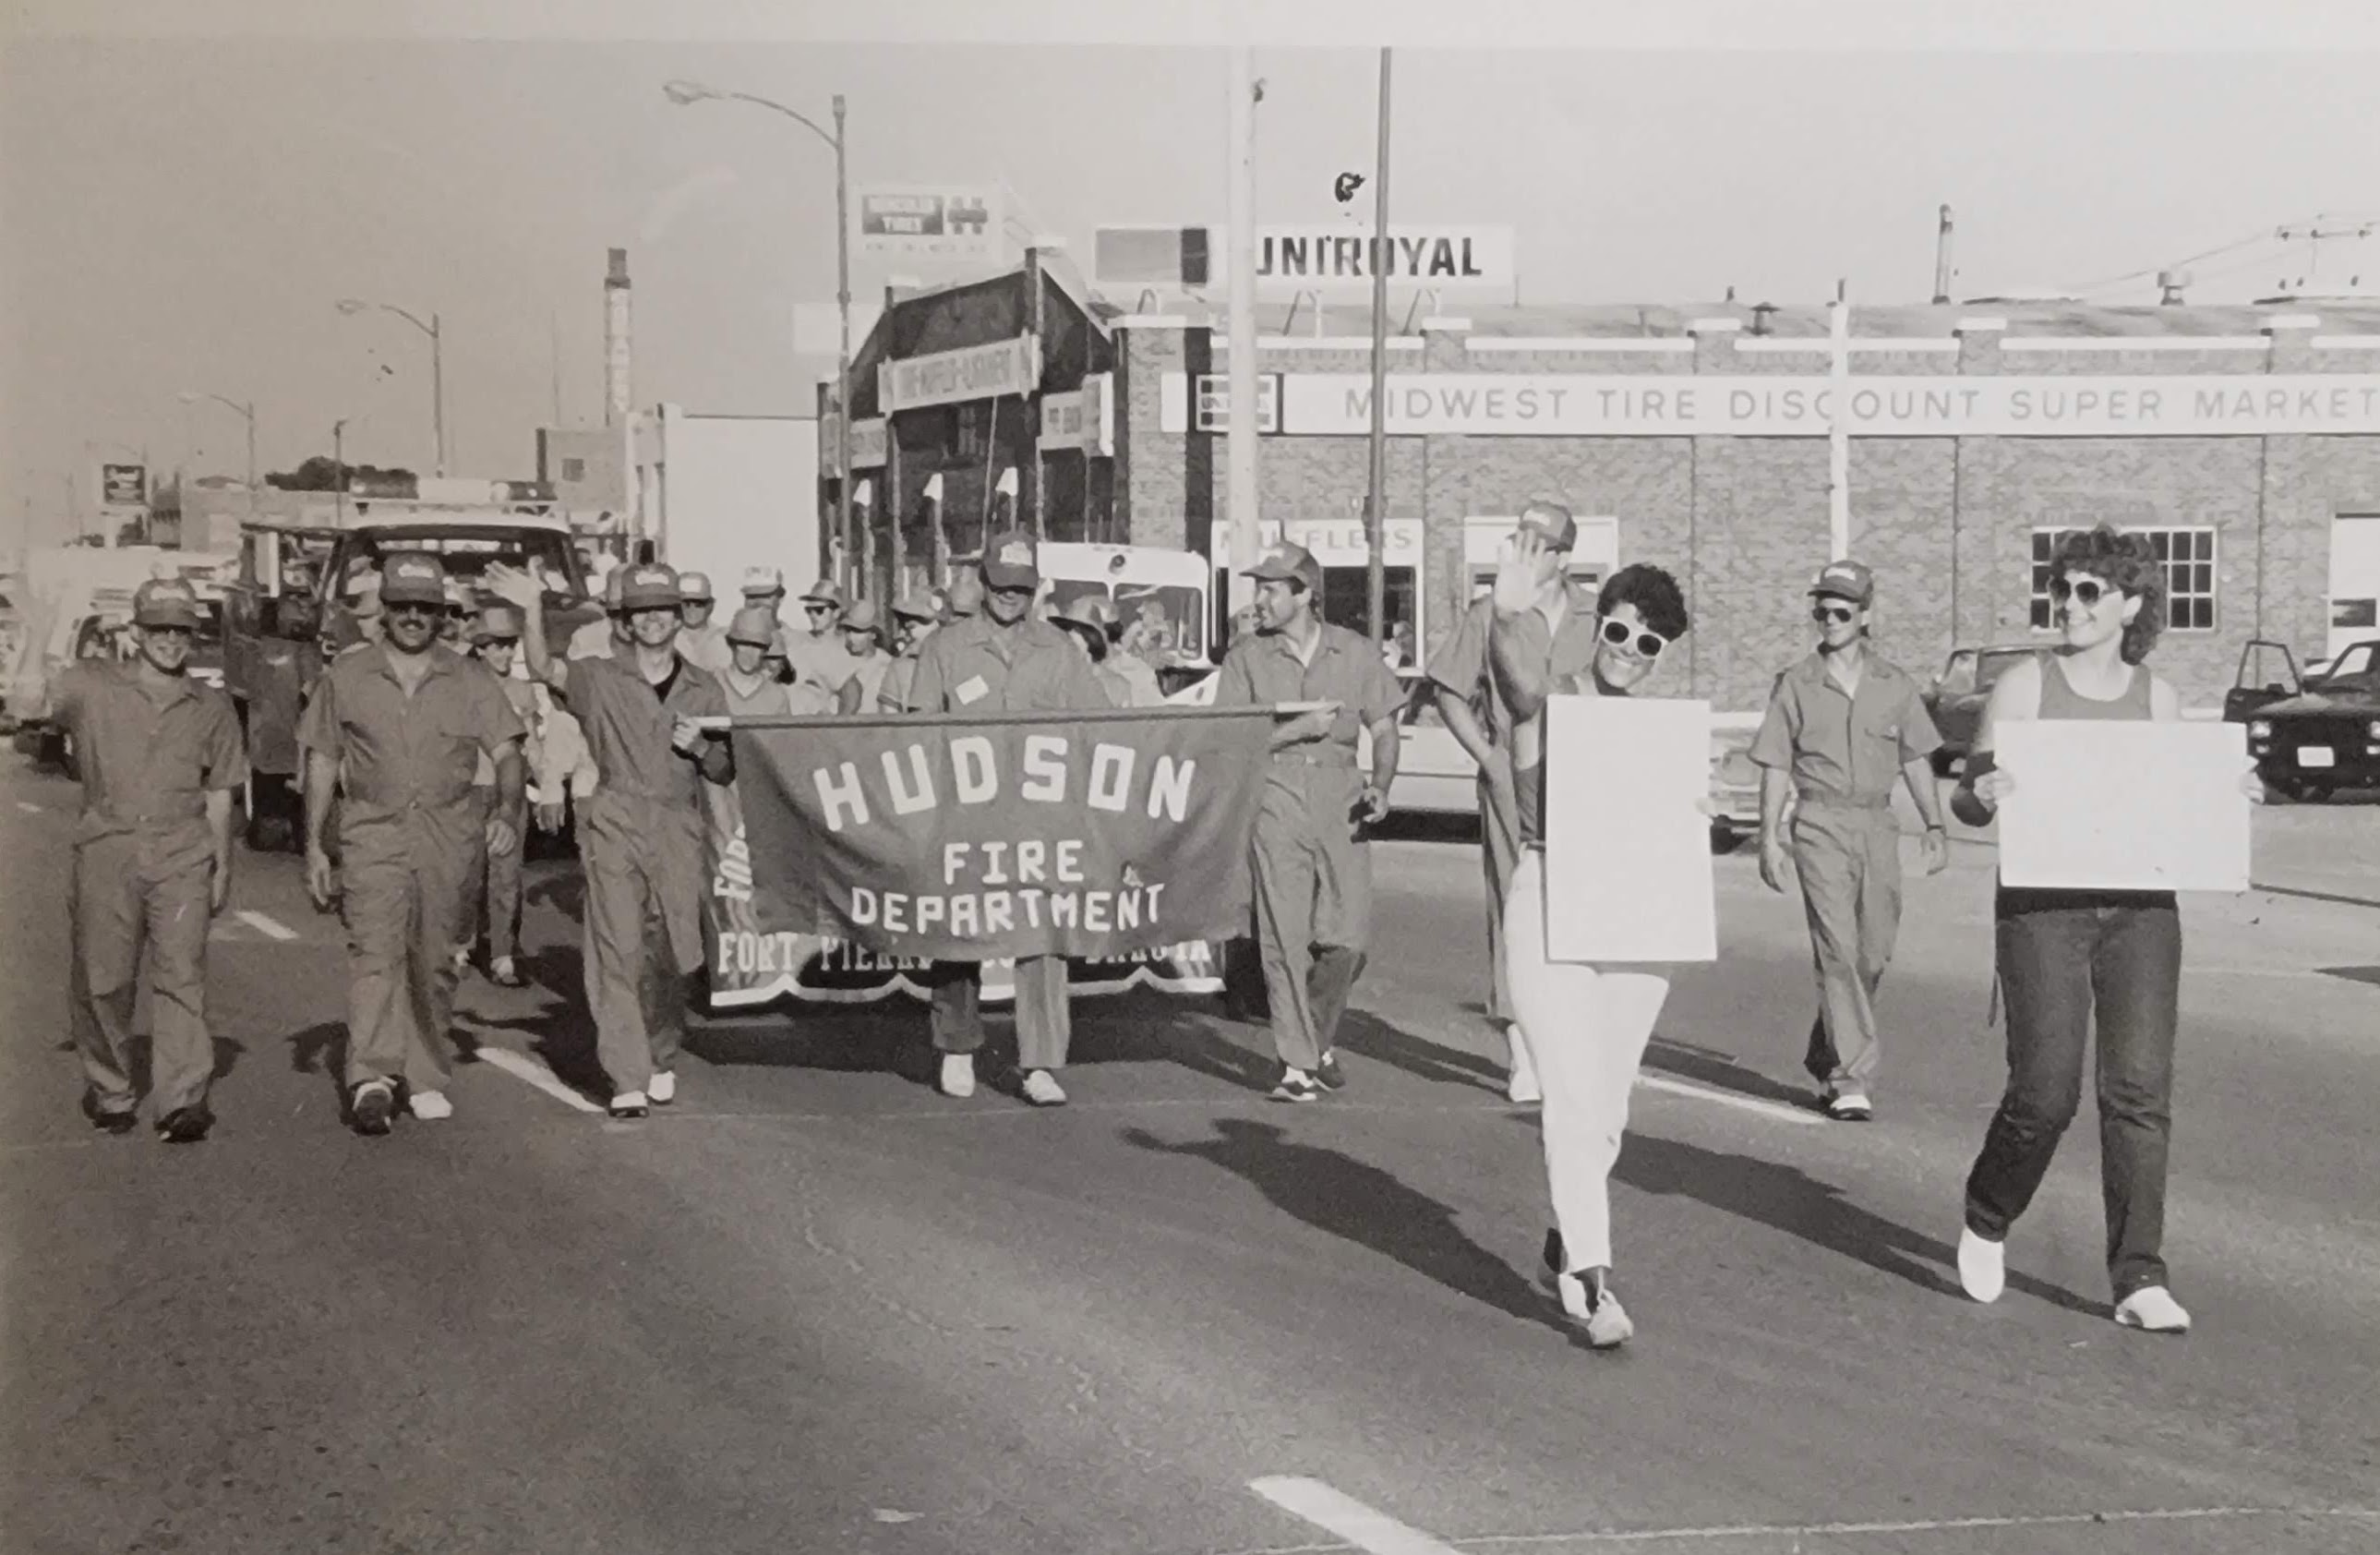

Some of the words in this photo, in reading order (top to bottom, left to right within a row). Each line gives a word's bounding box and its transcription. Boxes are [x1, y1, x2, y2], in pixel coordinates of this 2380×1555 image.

[1344, 388, 1569, 420] MIDWEST
[1597, 389, 1698, 419] TIRE
[1729, 389, 1980, 421] DISCOUNT
[2009, 389, 2163, 420] SUPER
[2194, 387, 2378, 419] MARKET
[1220, 529, 1413, 554] UFLES
[812, 735, 1196, 831] HUDSON
[944, 839, 1085, 885] FIRE
[851, 883, 1165, 936] DEPARTMENT
[717, 931, 799, 974] FORT
